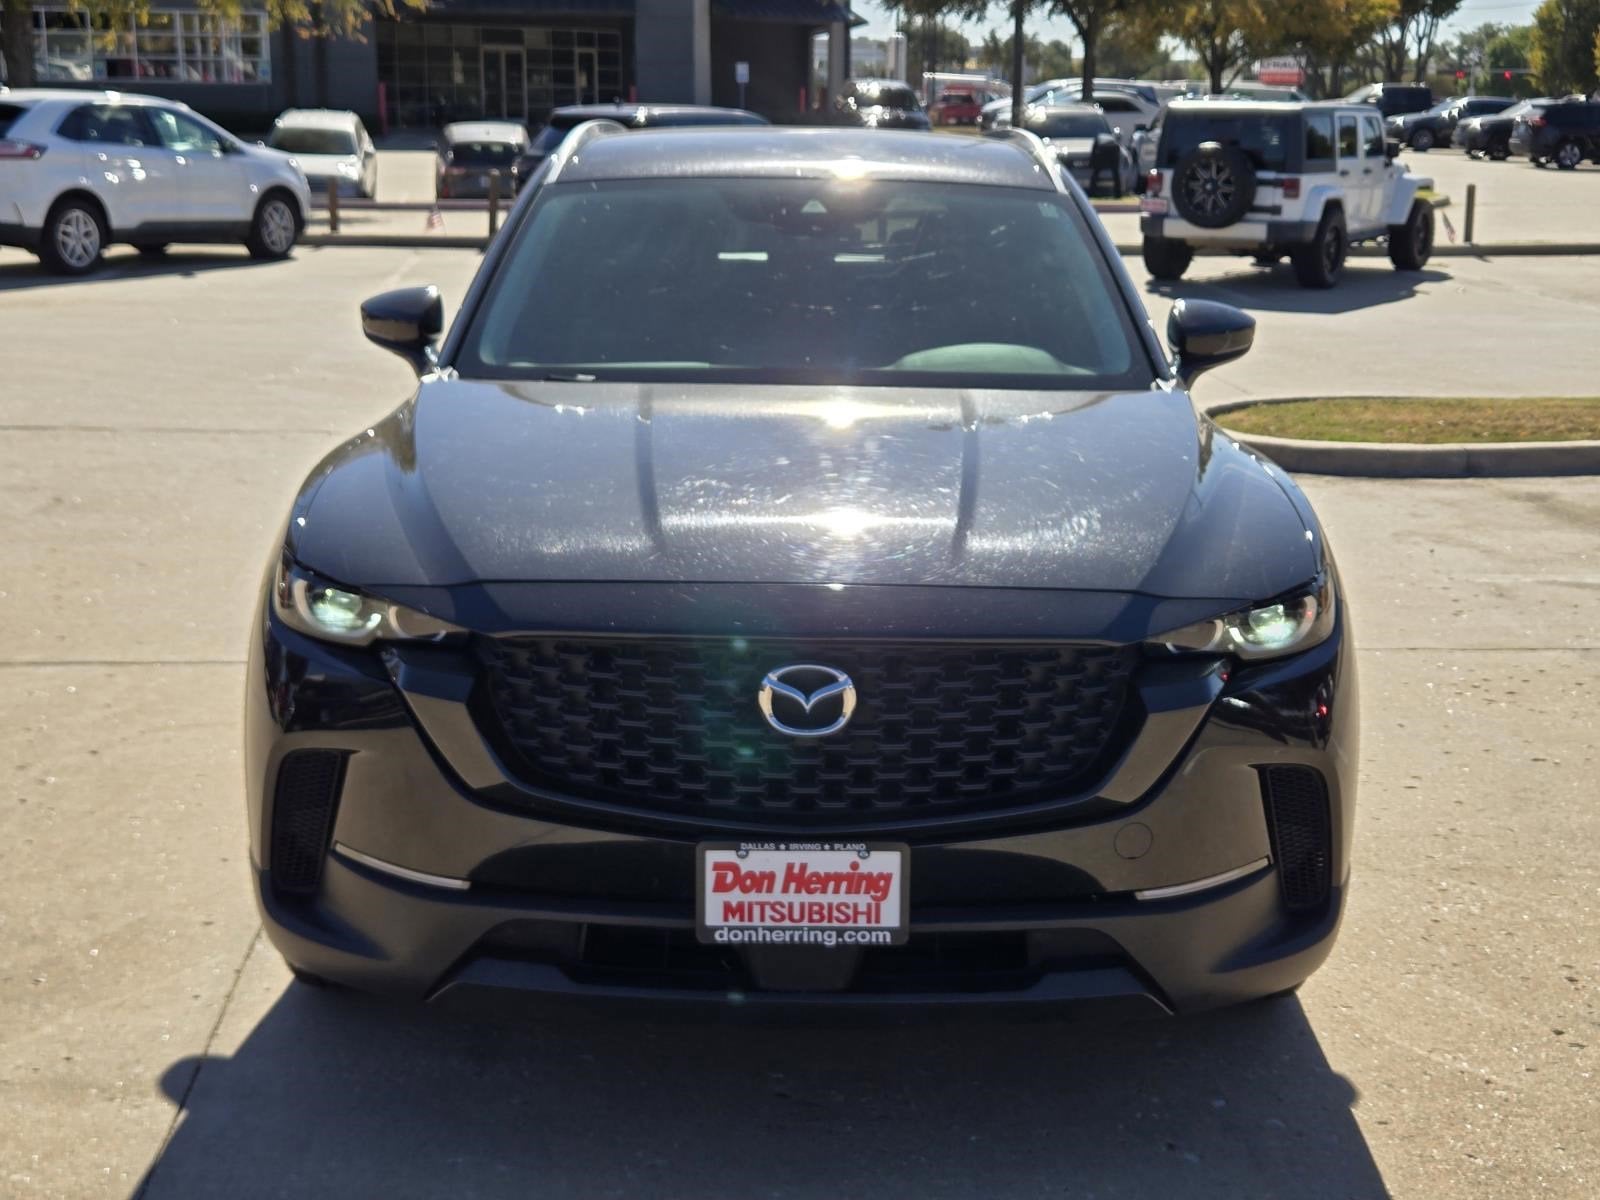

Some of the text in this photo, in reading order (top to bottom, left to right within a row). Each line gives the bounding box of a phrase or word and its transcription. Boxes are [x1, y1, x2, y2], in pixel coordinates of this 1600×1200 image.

[712, 861, 893, 902] Don Herring
[723, 901, 881, 924] MITSUBISHI
[714, 927, 892, 946] donherring.com
